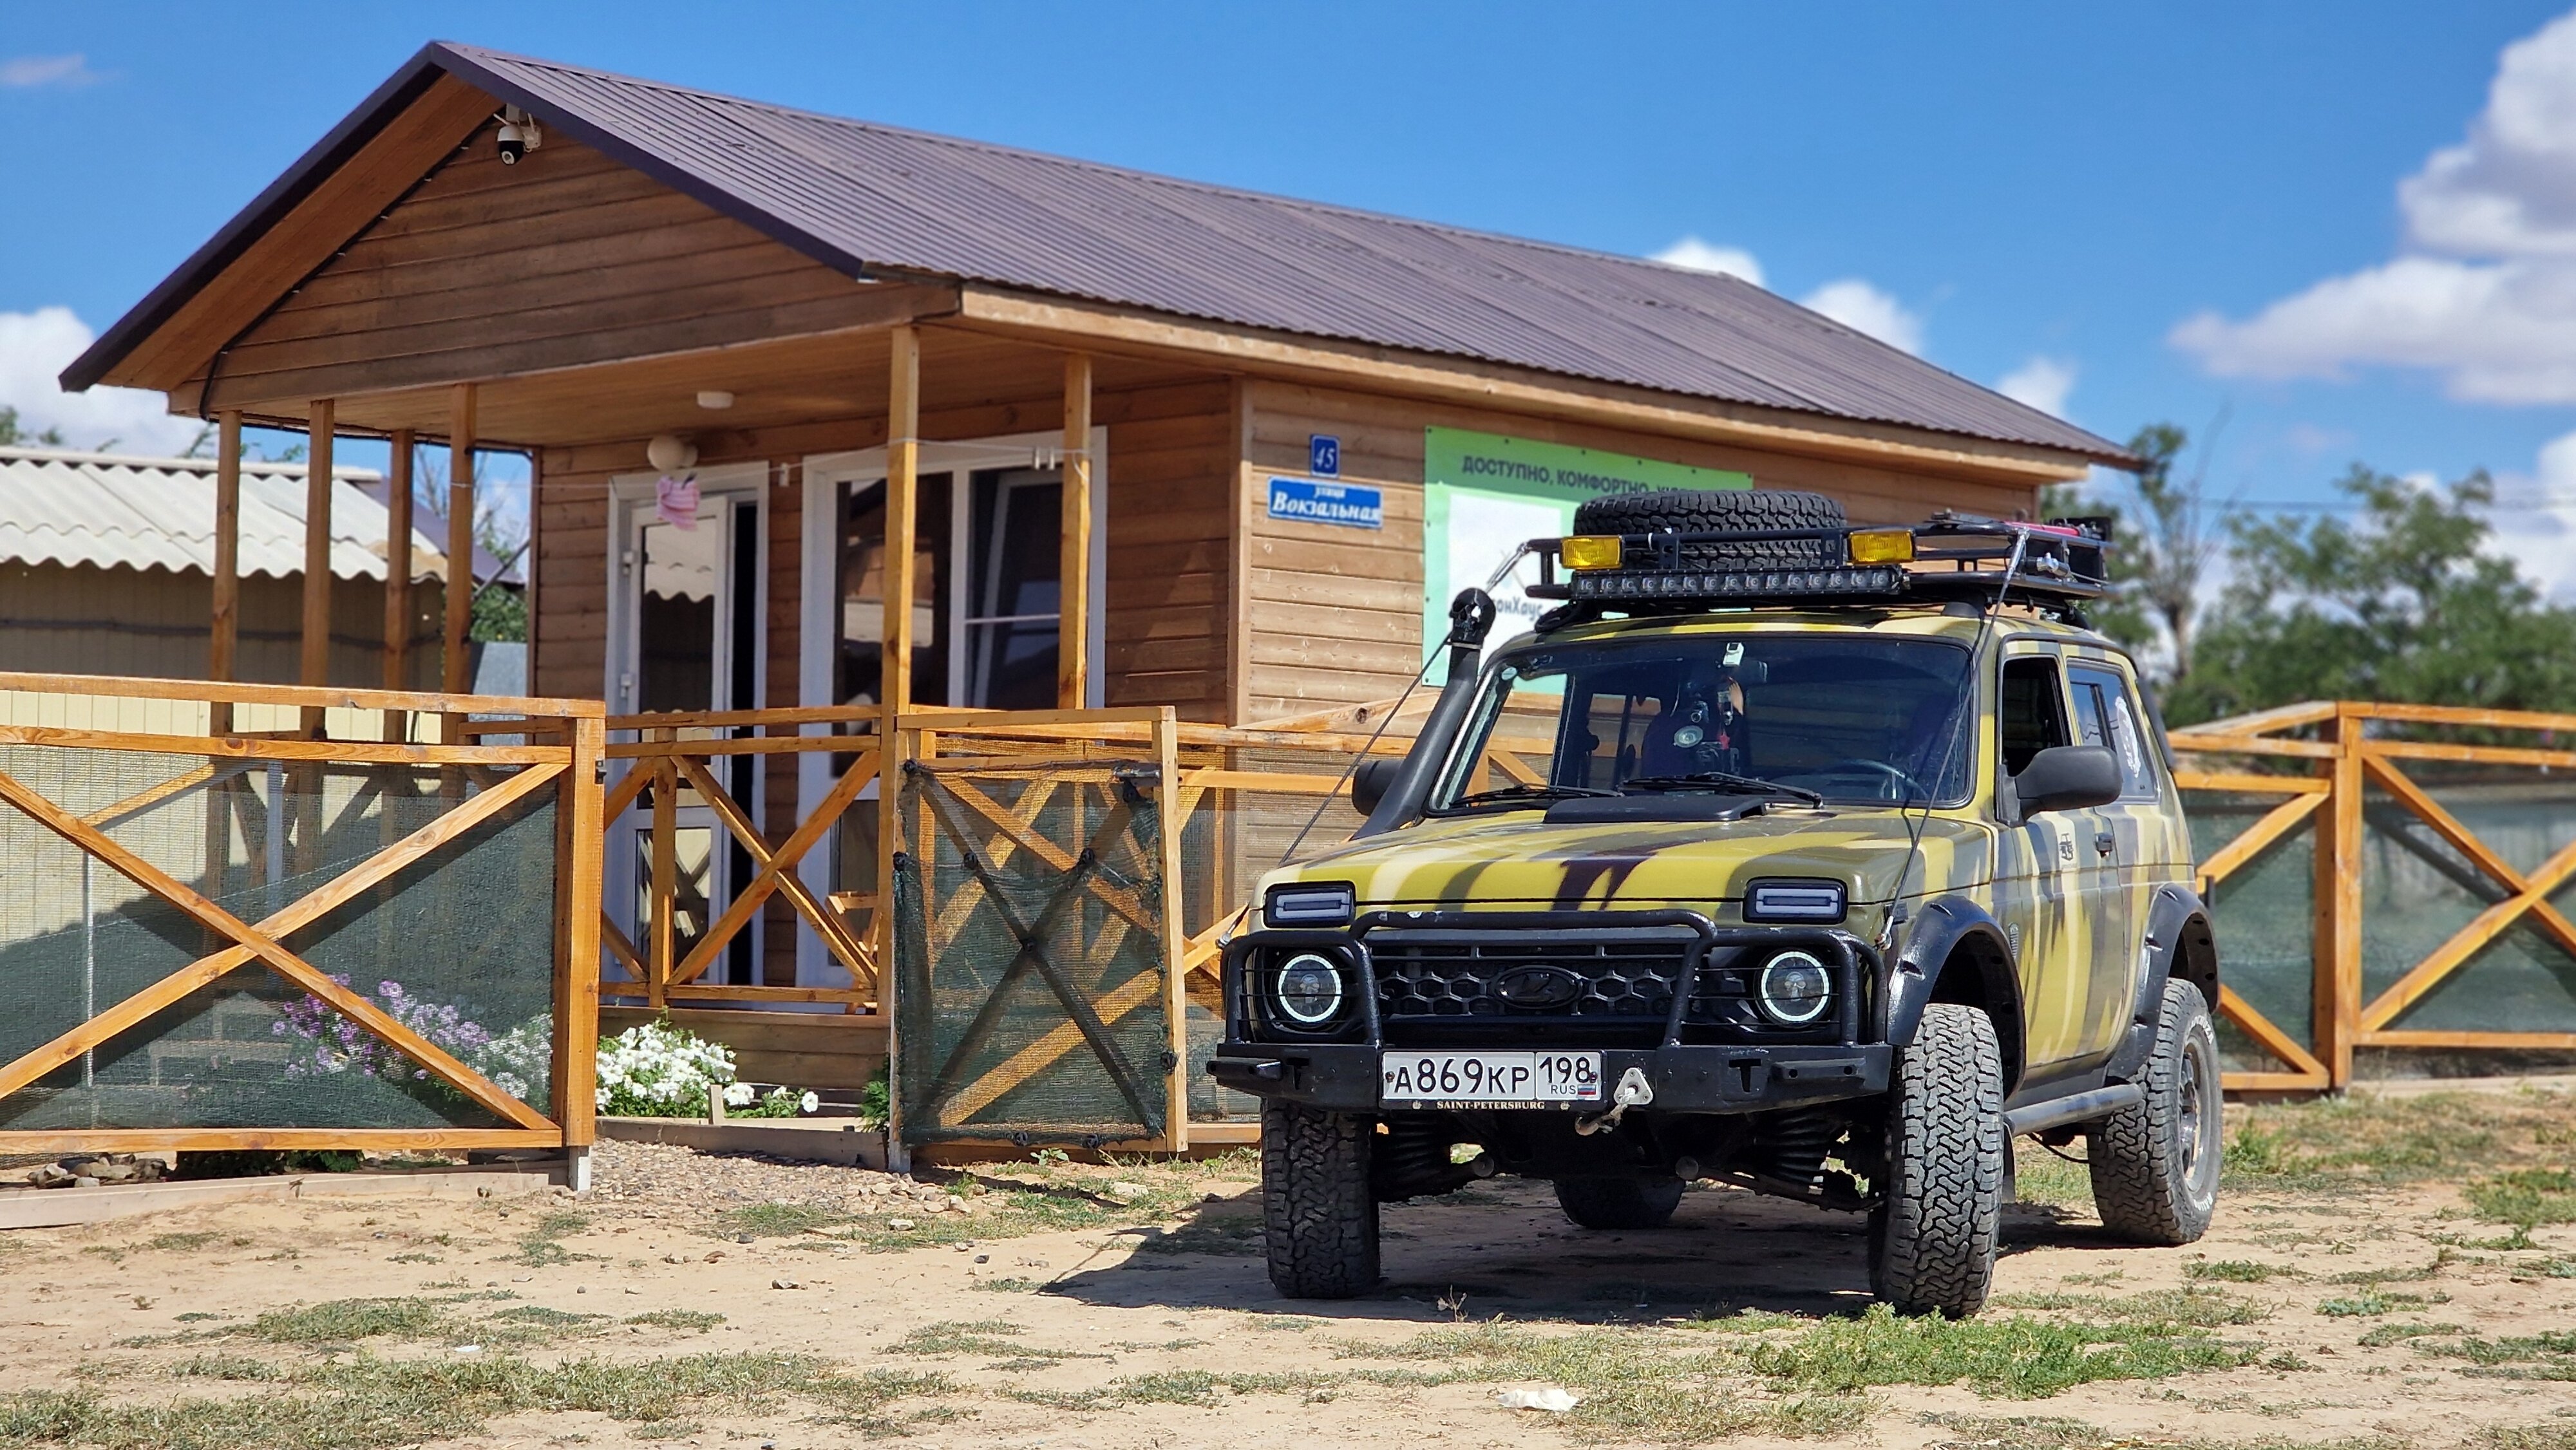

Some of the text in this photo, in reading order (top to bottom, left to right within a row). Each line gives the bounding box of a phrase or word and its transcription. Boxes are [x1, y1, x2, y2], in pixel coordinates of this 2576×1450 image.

[1314, 447, 1335, 469] 45
[1462, 455, 1554, 485] ДОСТУПНО,
[1273, 491, 1381, 521] Вокзальная
[1539, 1056, 1594, 1084] 198
[1550, 1085, 1577, 1095] RUS
[1437, 1101, 1545, 1110] SAINT-PETERSBURG
